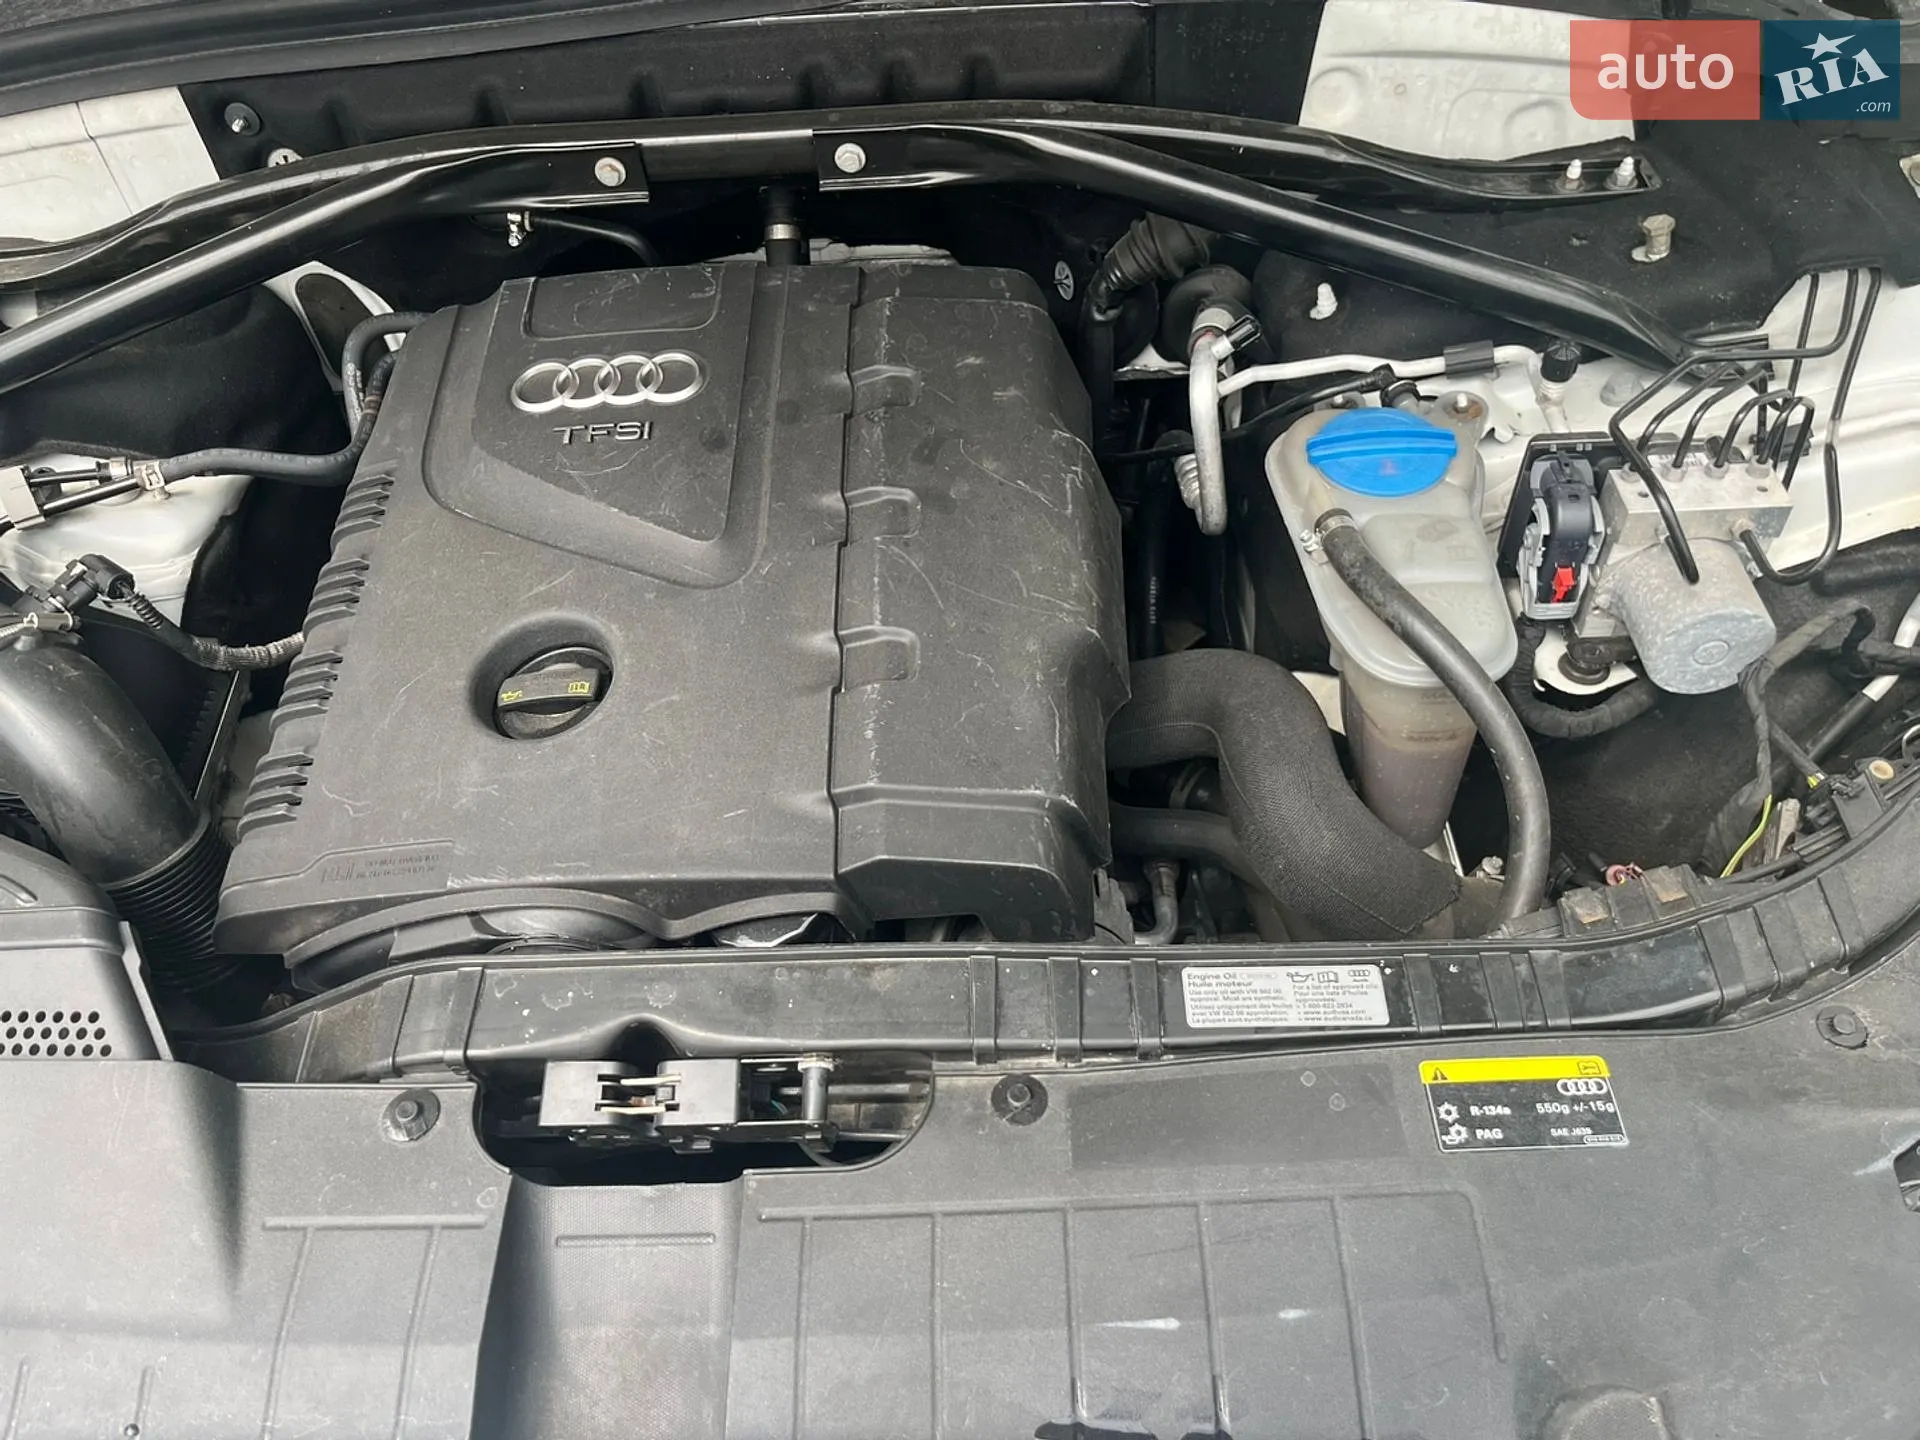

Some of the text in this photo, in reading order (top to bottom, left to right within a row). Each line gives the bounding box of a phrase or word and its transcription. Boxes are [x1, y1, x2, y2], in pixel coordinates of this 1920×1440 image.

[552, 421, 653, 445] TFSI
[1187, 973, 1221, 981] Engine
[1223, 972, 1237, 980] Oil
[1470, 1104, 1512, 1116] R-134a
[1536, 1102, 1570, 1115] 550g
[1475, 1127, 1504, 1140] PAG
[1551, 1128, 1568, 1137] SAE
